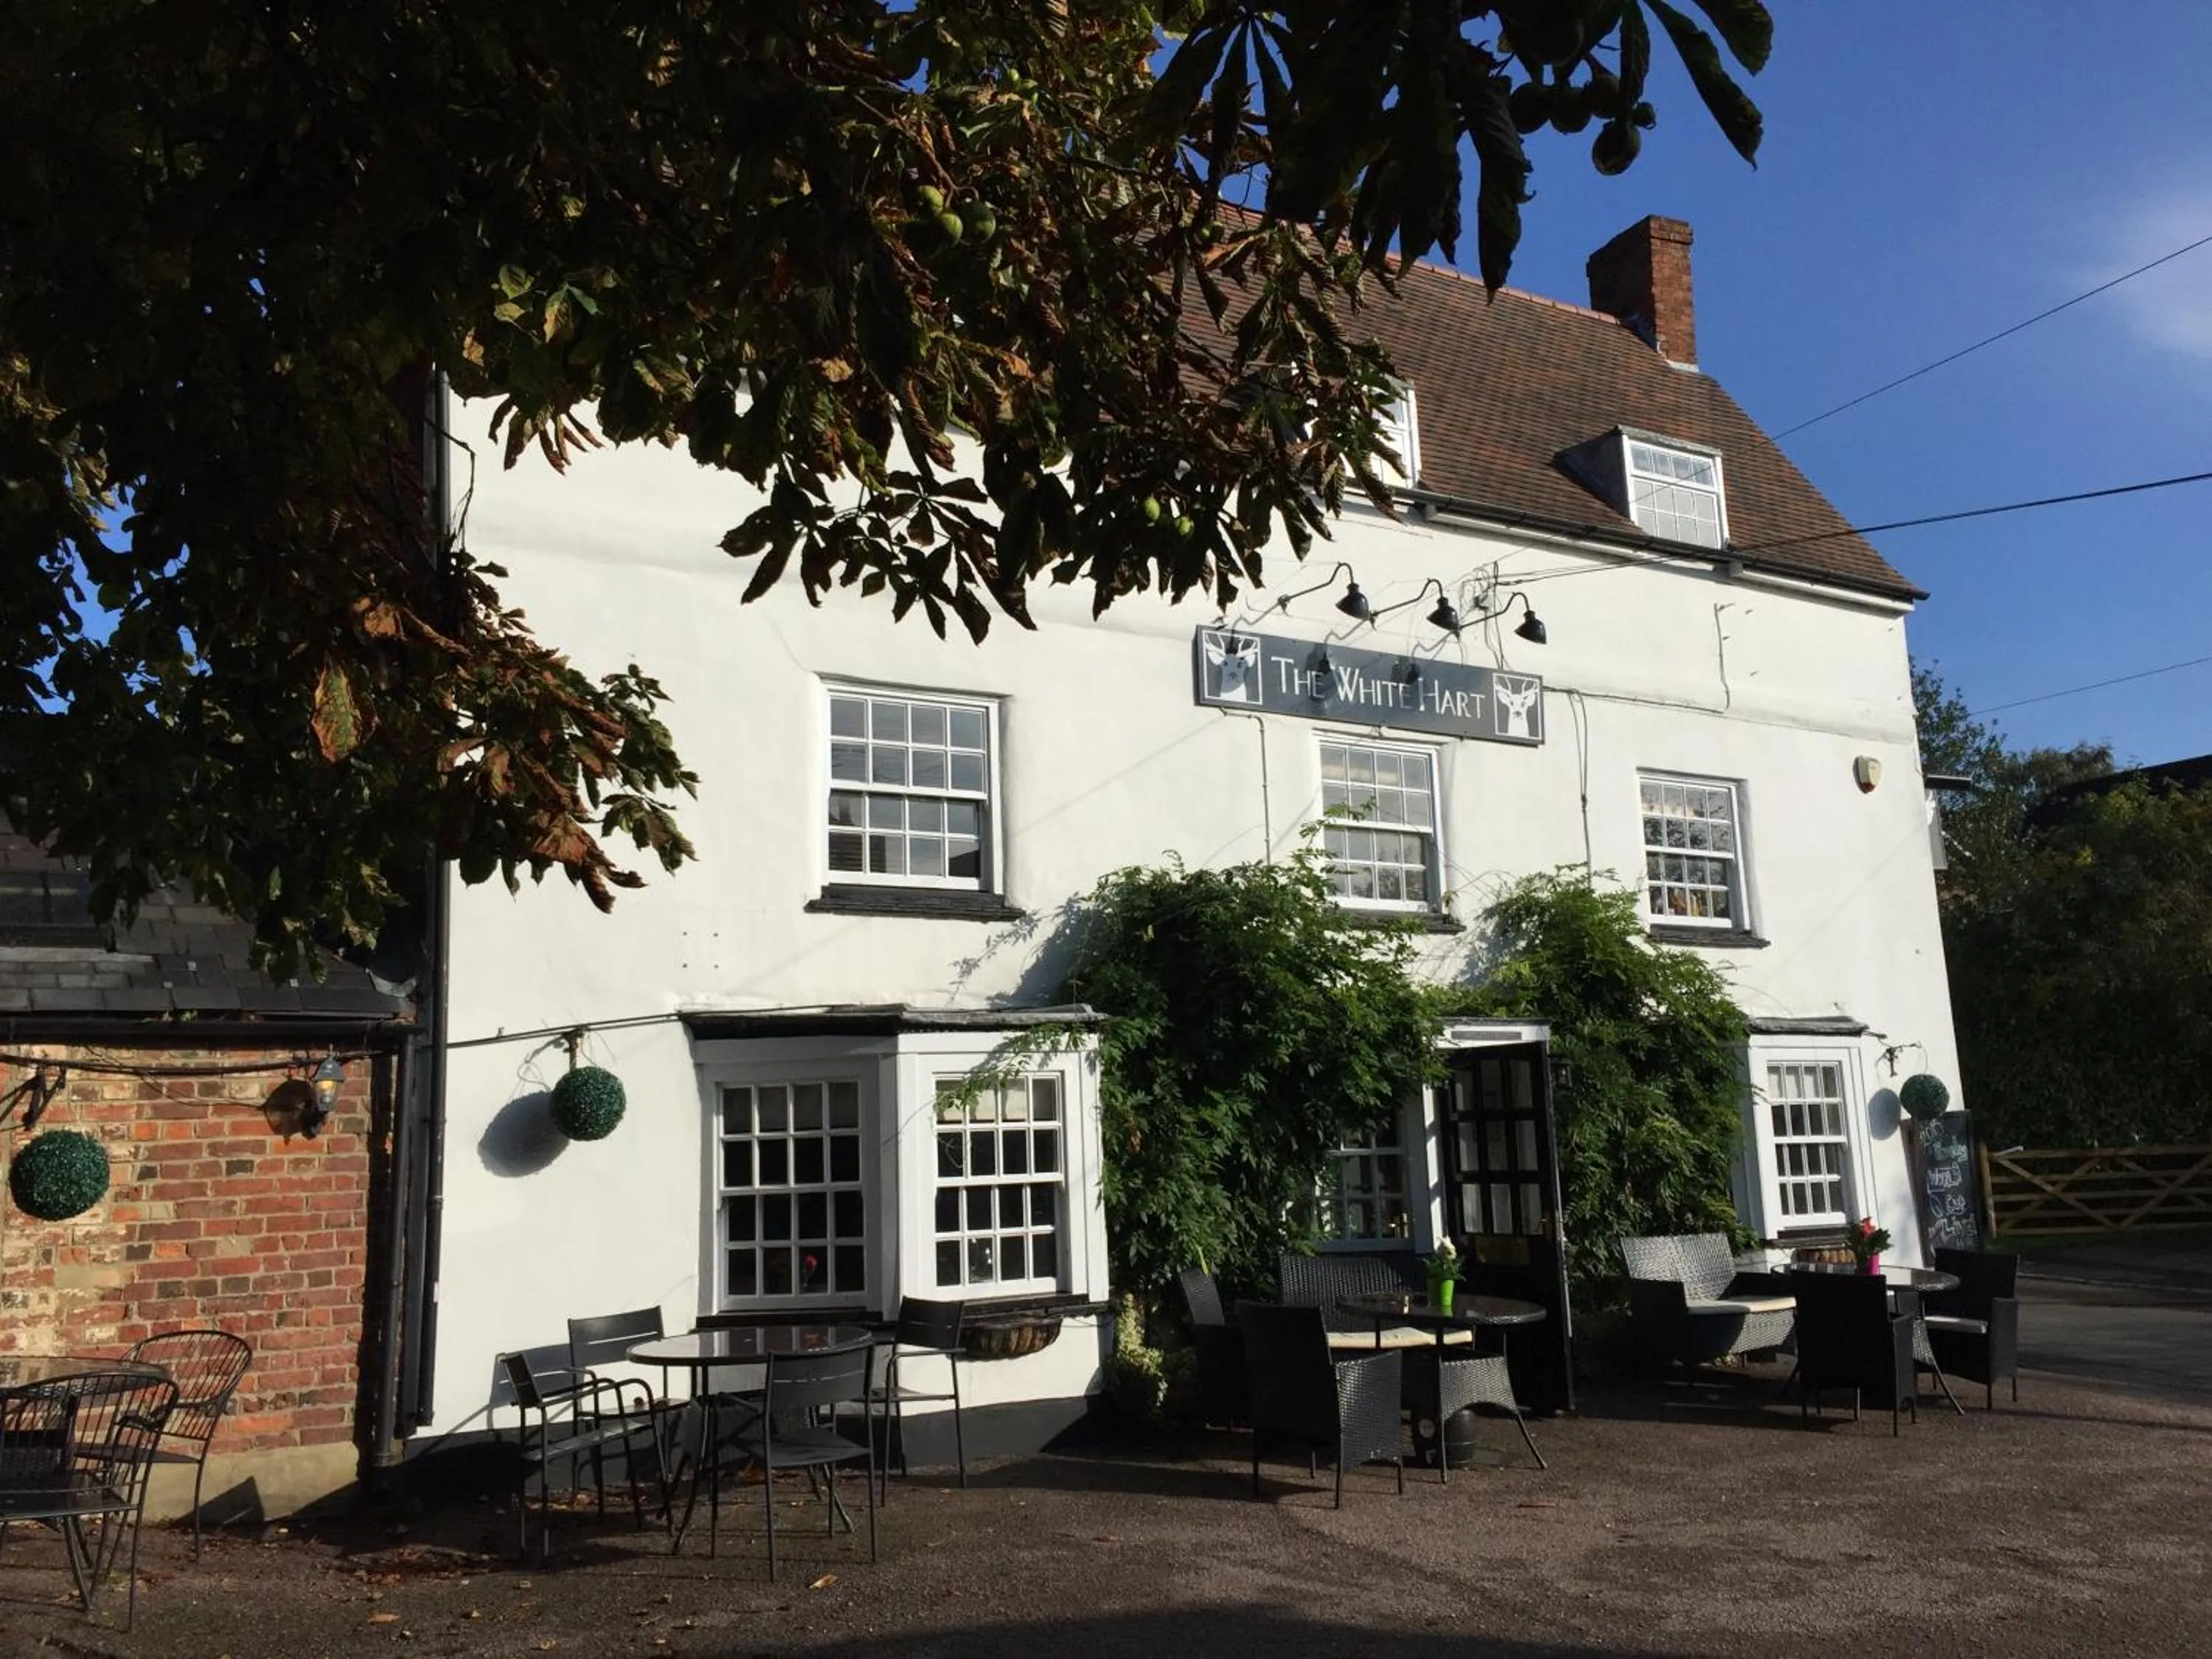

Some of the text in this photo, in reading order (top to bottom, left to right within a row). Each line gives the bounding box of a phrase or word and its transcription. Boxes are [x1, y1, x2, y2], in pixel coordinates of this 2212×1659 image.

[1270, 655, 1486, 720] THE WHITE HART
